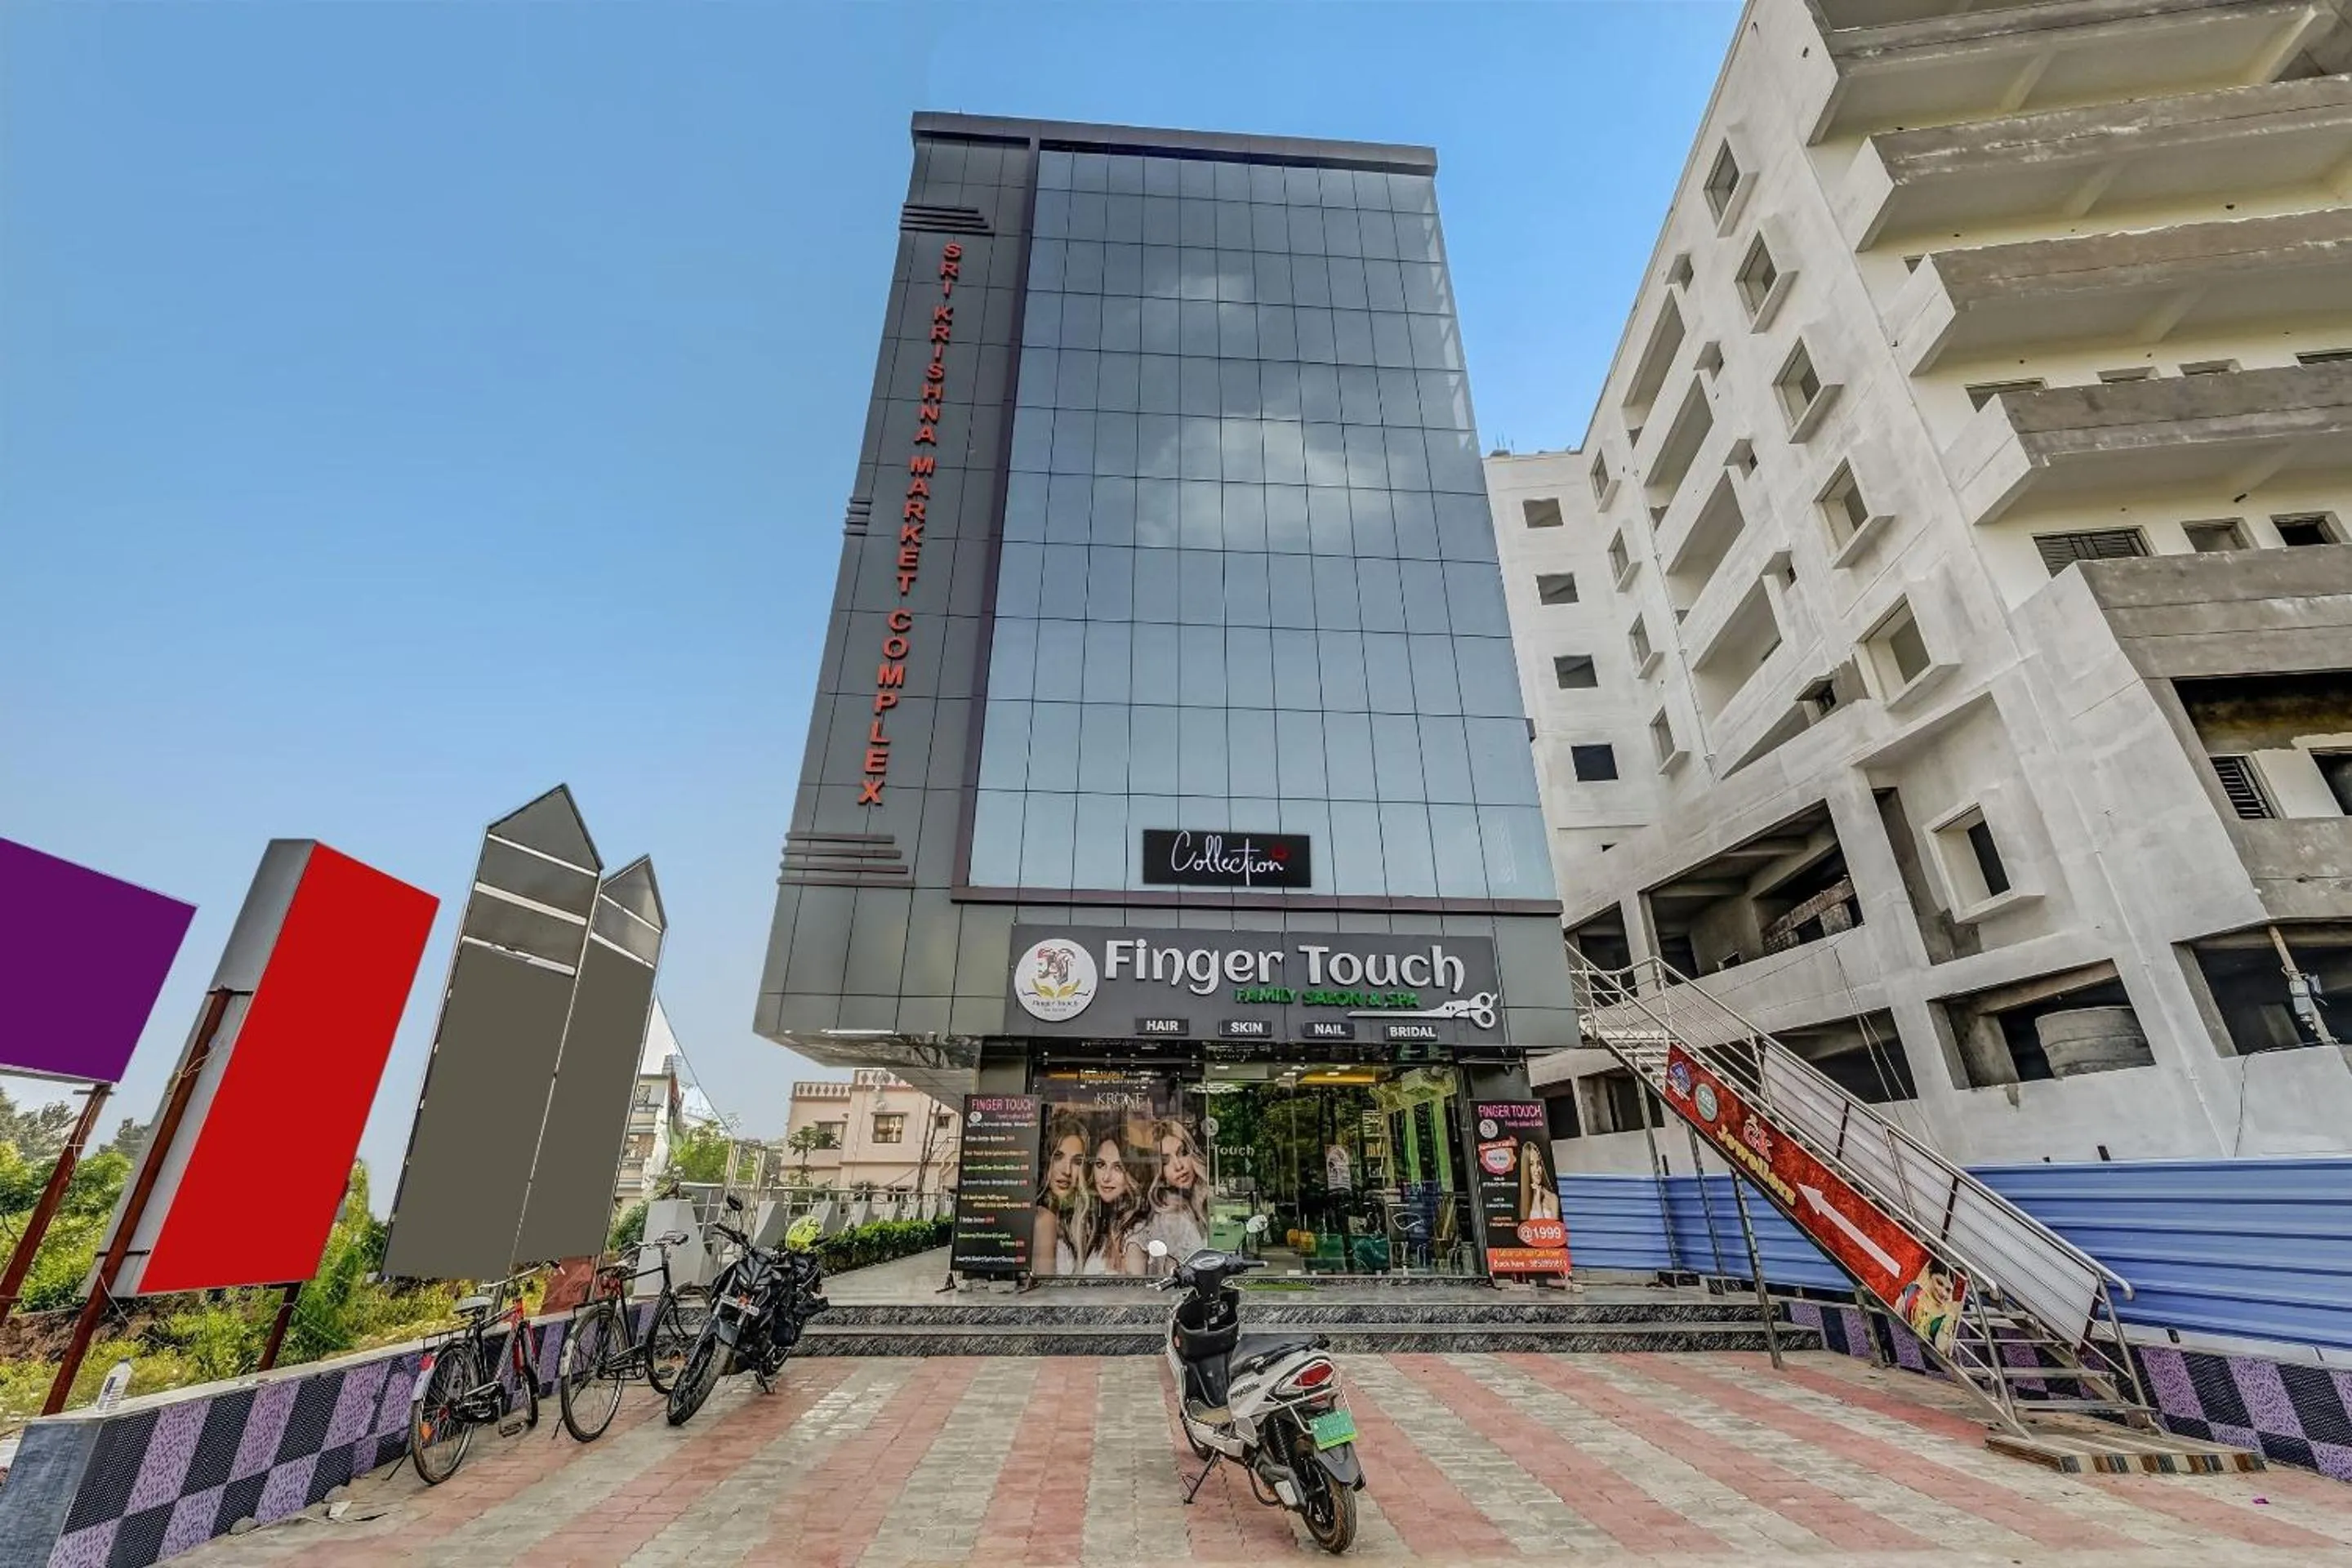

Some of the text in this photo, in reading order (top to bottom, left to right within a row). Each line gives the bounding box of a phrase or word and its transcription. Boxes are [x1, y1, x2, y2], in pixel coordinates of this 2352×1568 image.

[858, 243, 962, 805] SRI KRISHNA MARKET COMPLEX
[1170, 830, 1284, 886] Collection
[1104, 938, 1465, 996] Finger Touch
[1235, 987, 1419, 1008] FAMILY SALON & SPA
[1146, 1020, 1178, 1032] HAIR
[1230, 1022, 1263, 1034] SKIN
[1314, 1023, 1346, 1036] NAIL
[1389, 1026, 1437, 1038] BRIDAL
[971, 1098, 1036, 1111] FINGER TOUCH
[1478, 1104, 1543, 1118] FINGER TOUCH
[1717, 1123, 1797, 1206] Jewellers
[1521, 1226, 1561, 1242] @1999
